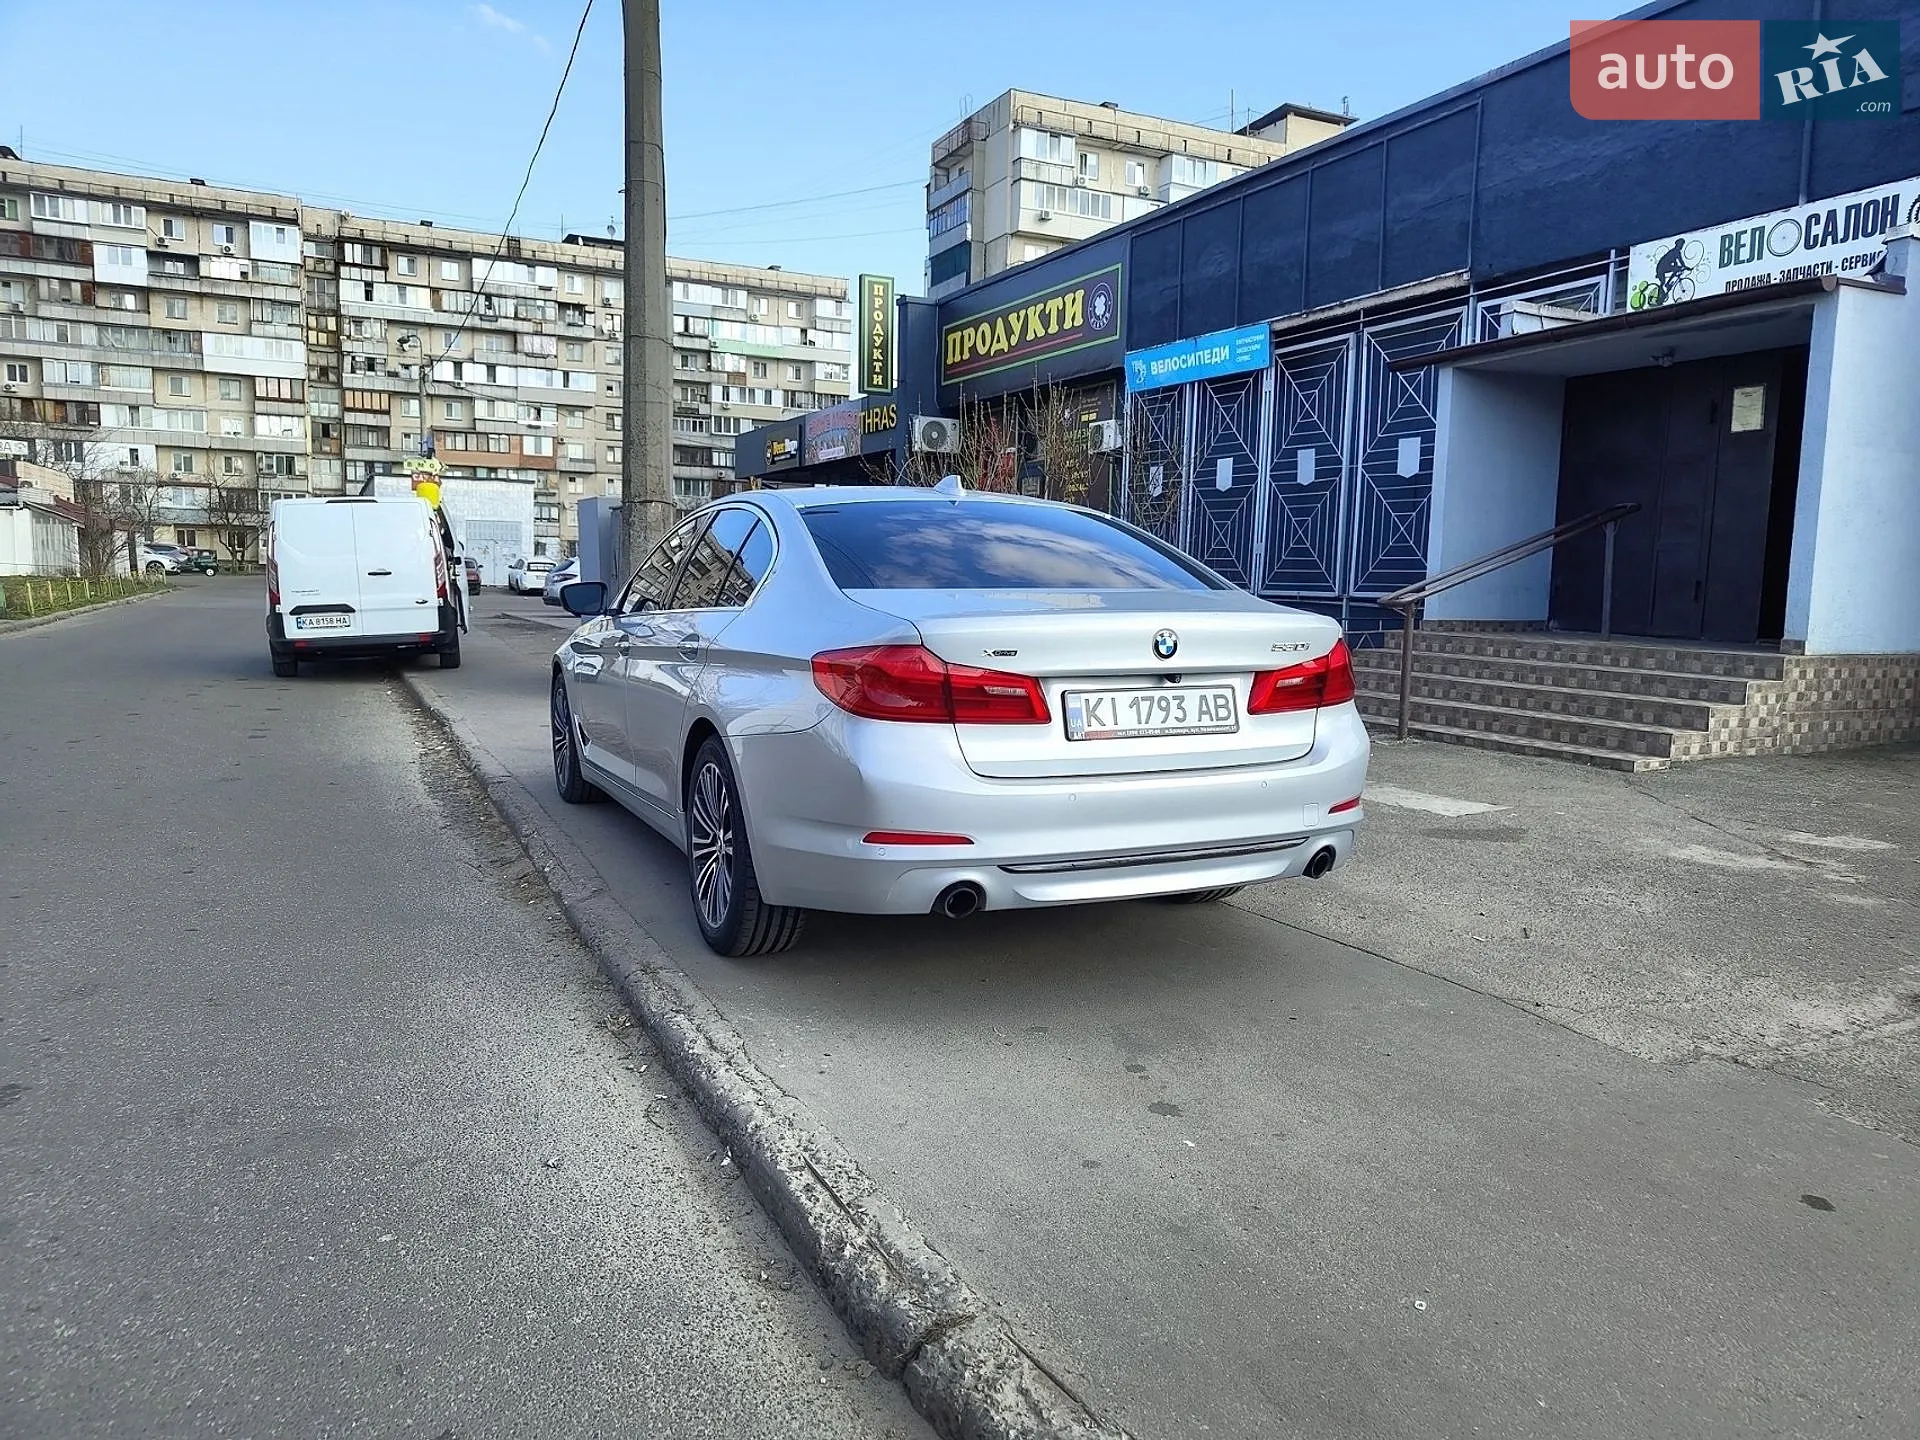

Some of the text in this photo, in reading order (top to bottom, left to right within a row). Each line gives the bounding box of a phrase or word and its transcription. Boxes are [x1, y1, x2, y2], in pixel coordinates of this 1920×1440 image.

[1718, 193, 1900, 269] ВЕЛОСАЛОН
[872, 284, 884, 386] ПРОДУКТИ
[946, 289, 1085, 365] ПРОДУКТИ
[1150, 344, 1230, 376] ВЕЛОСИПЕДИ
[1085, 693, 1232, 727] KI 1793 AB
